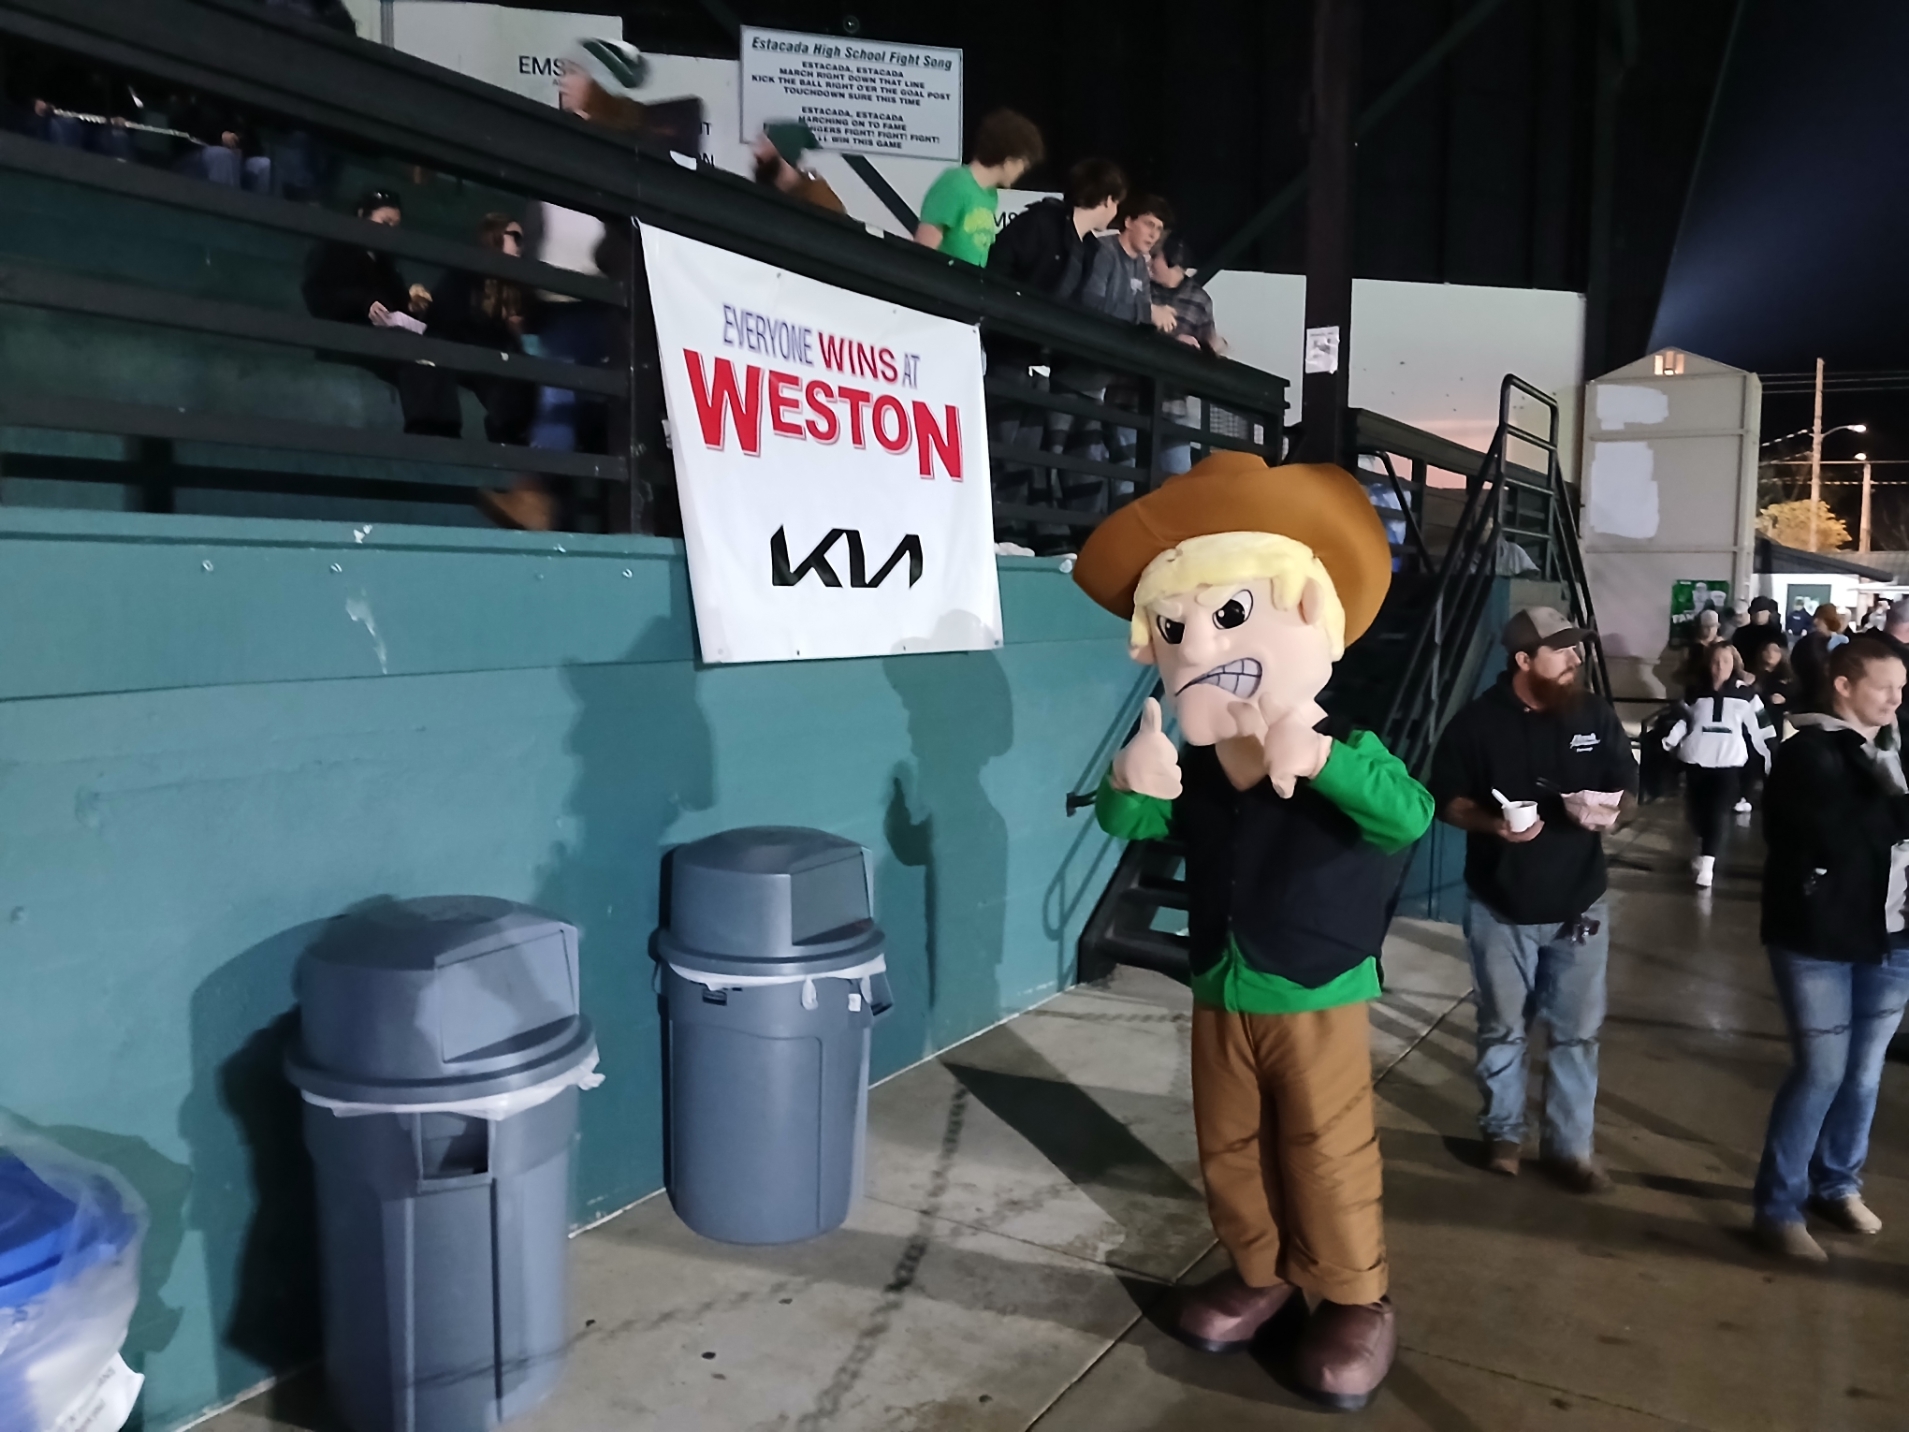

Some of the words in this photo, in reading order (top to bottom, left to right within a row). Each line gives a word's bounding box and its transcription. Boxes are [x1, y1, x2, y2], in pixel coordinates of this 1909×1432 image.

[752, 36, 809, 54] Estacada
[813, 43, 841, 59] High
[845, 46, 886, 61] School
[889, 51, 920, 67] Fight
[923, 55, 952, 71] Song
[779, 67, 814, 78] MARCH
[816, 71, 846, 81] RIGHT
[848, 74, 876, 84] DOWN
[879, 77, 902, 87] THAT
[904, 80, 925, 90] LINE
[802, 61, 853, 73] ESTACADA,
[856, 66, 904, 78] ESTACADA
[752, 74, 775, 83] KICK
[778, 76, 796, 86] THE
[799, 78, 823, 88] BALL
[825, 81, 854, 91] RIGHT
[880, 86, 898, 96] THE
[900, 88, 924, 98] GOAL
[927, 92, 951, 101] POST
[783, 86, 846, 99] TOUCHDOWN
[848, 92, 872, 102] SURE
[876, 95, 897, 104] THIS
[899, 97, 921, 107] TIME
[798, 115, 849, 126] MARCHING
[851, 119, 865, 128] ON
[868, 121, 881, 130] TO
[882, 122, 907, 132] FAME
[801, 106, 853, 118] ESTACADA,
[856, 111, 904, 122] ESTACADA
[831, 136, 850, 144] WIN
[852, 138, 873, 147] THIS
[876, 139, 902, 149] GAME
[845, 128, 875, 138] FIGHT!
[877, 130, 907, 141] FIGHT!
[910, 134, 940, 144] FIGHT!
[722, 303, 814, 367] EVERYONE
[817, 330, 899, 385] WINS
[902, 352, 921, 389] AT
[683, 348, 964, 482] WESTON
[770, 524, 924, 589] KIA
